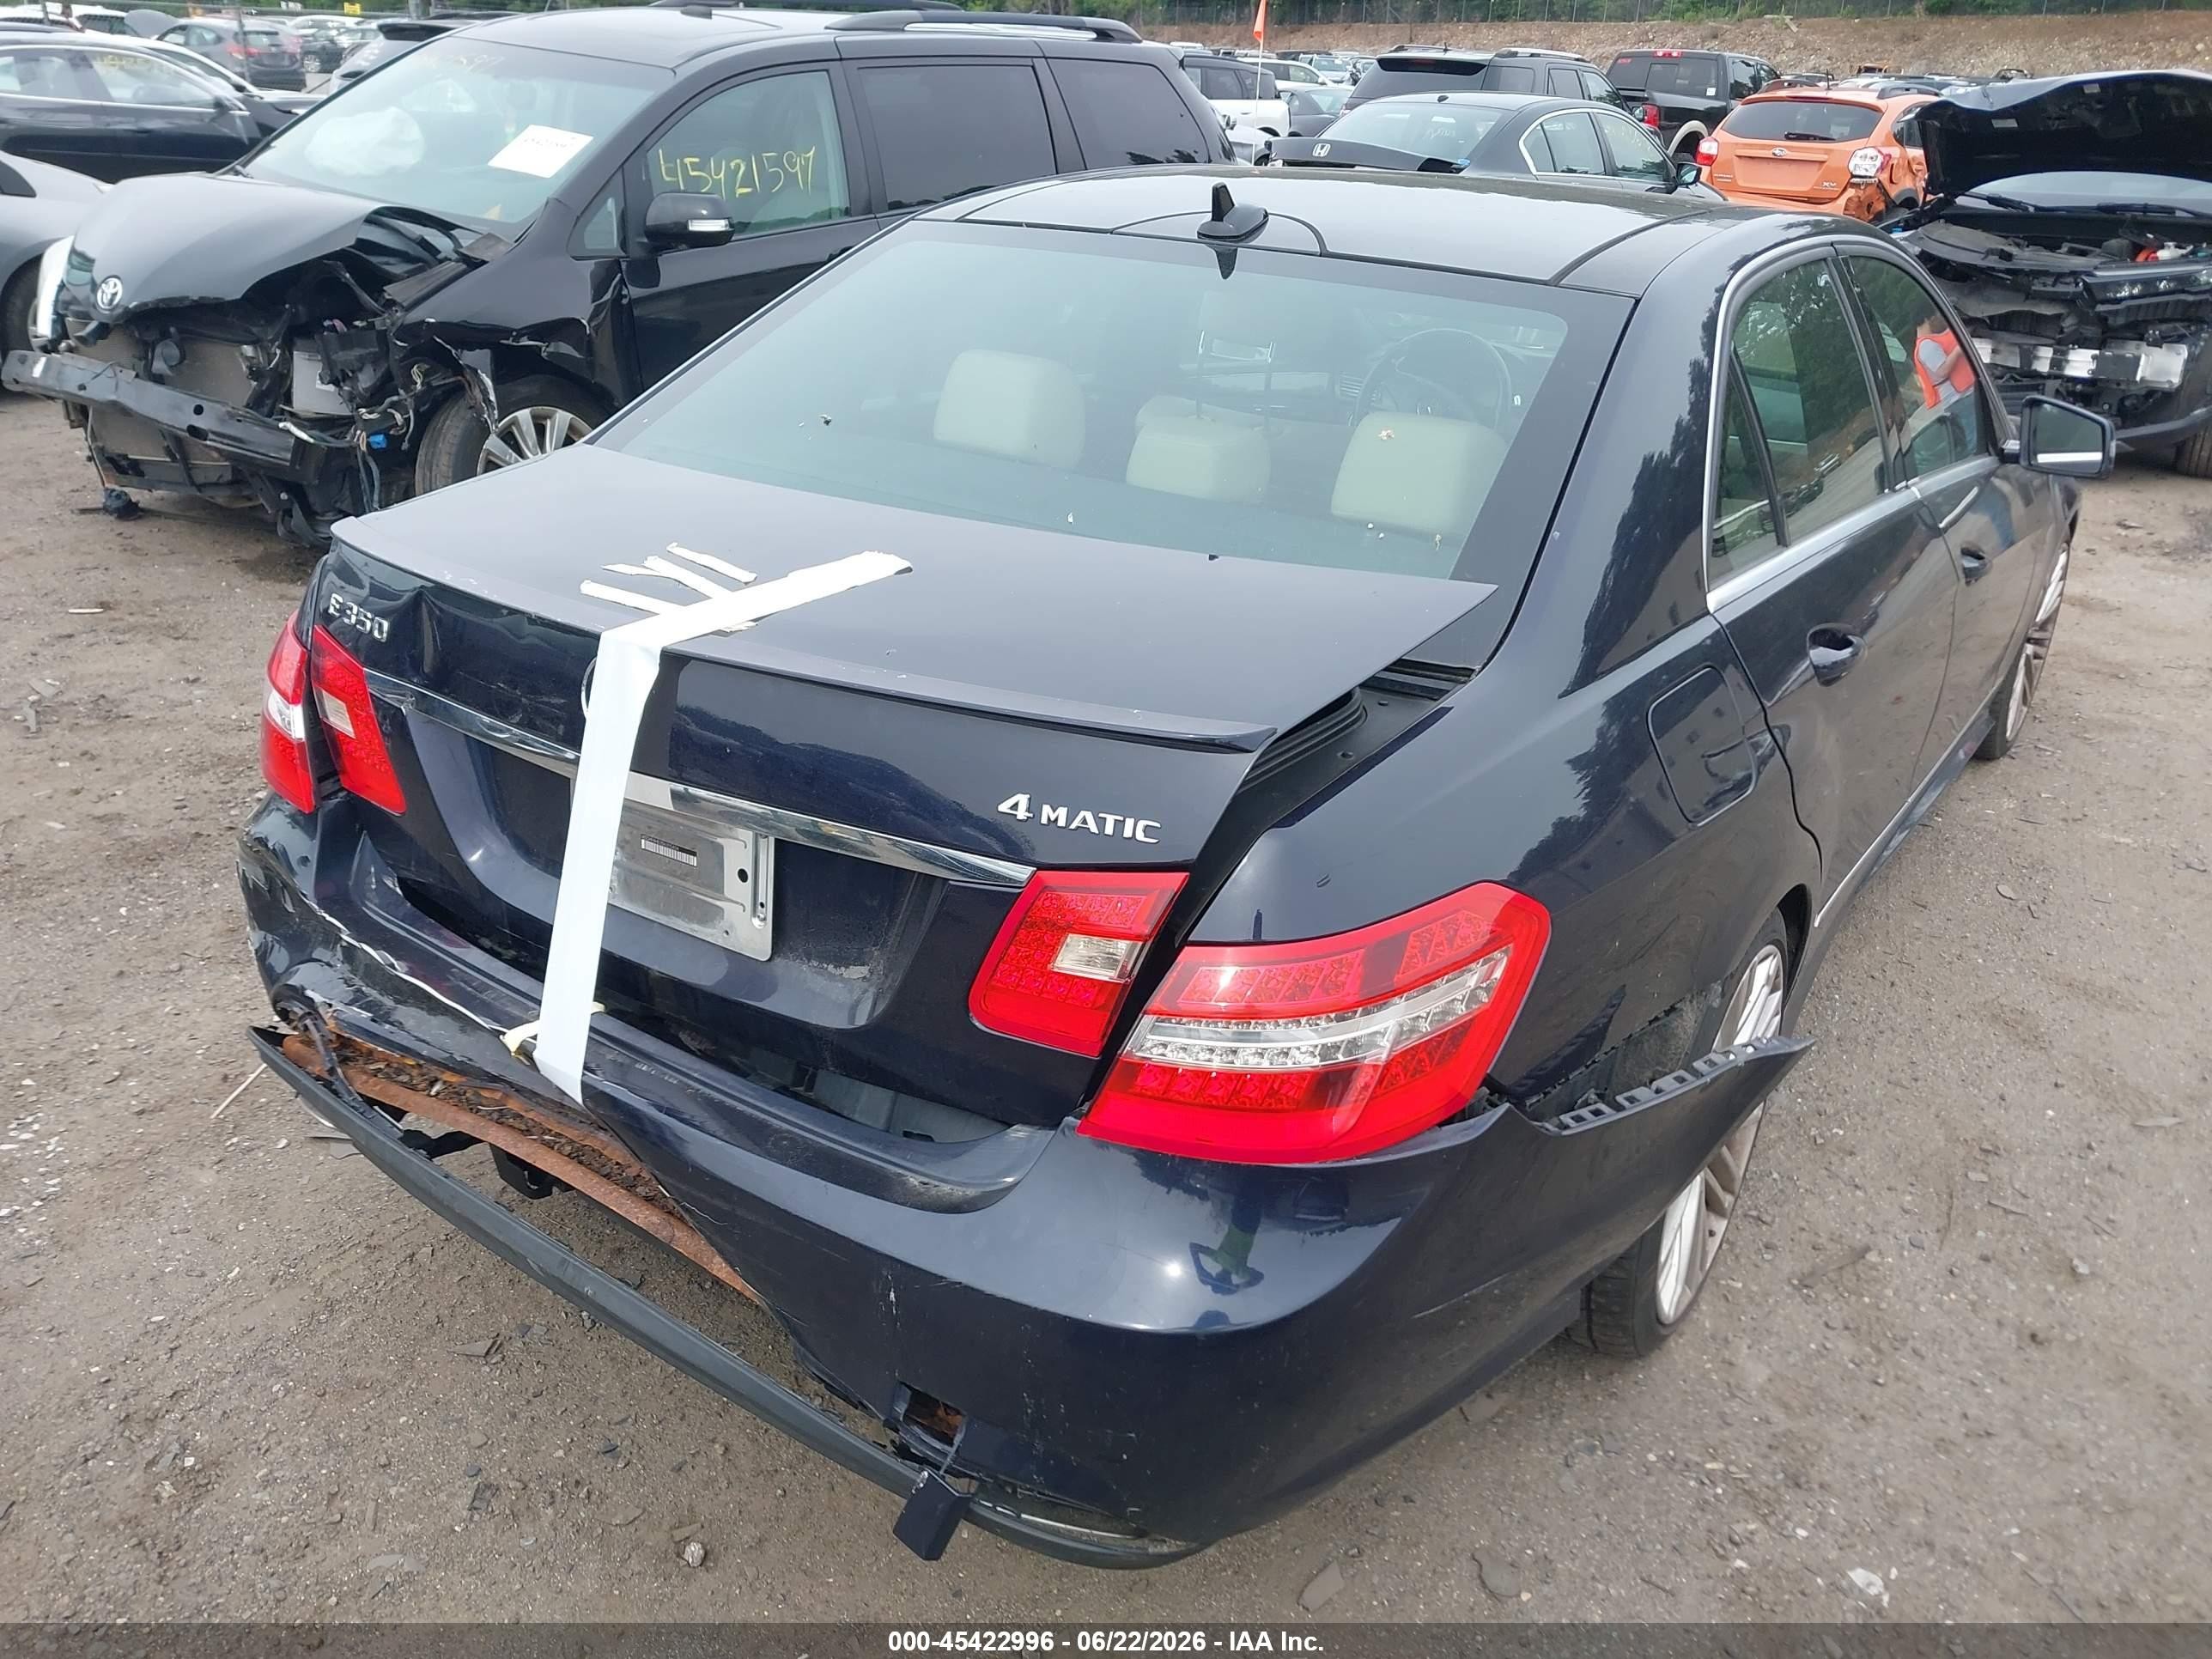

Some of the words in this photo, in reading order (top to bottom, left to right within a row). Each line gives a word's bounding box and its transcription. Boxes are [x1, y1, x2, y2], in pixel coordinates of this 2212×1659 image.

[659, 145, 816, 200] 45421597
[328, 592, 389, 642] E350
[997, 793, 1034, 820] 4
[1040, 804, 1162, 843] MATIC
